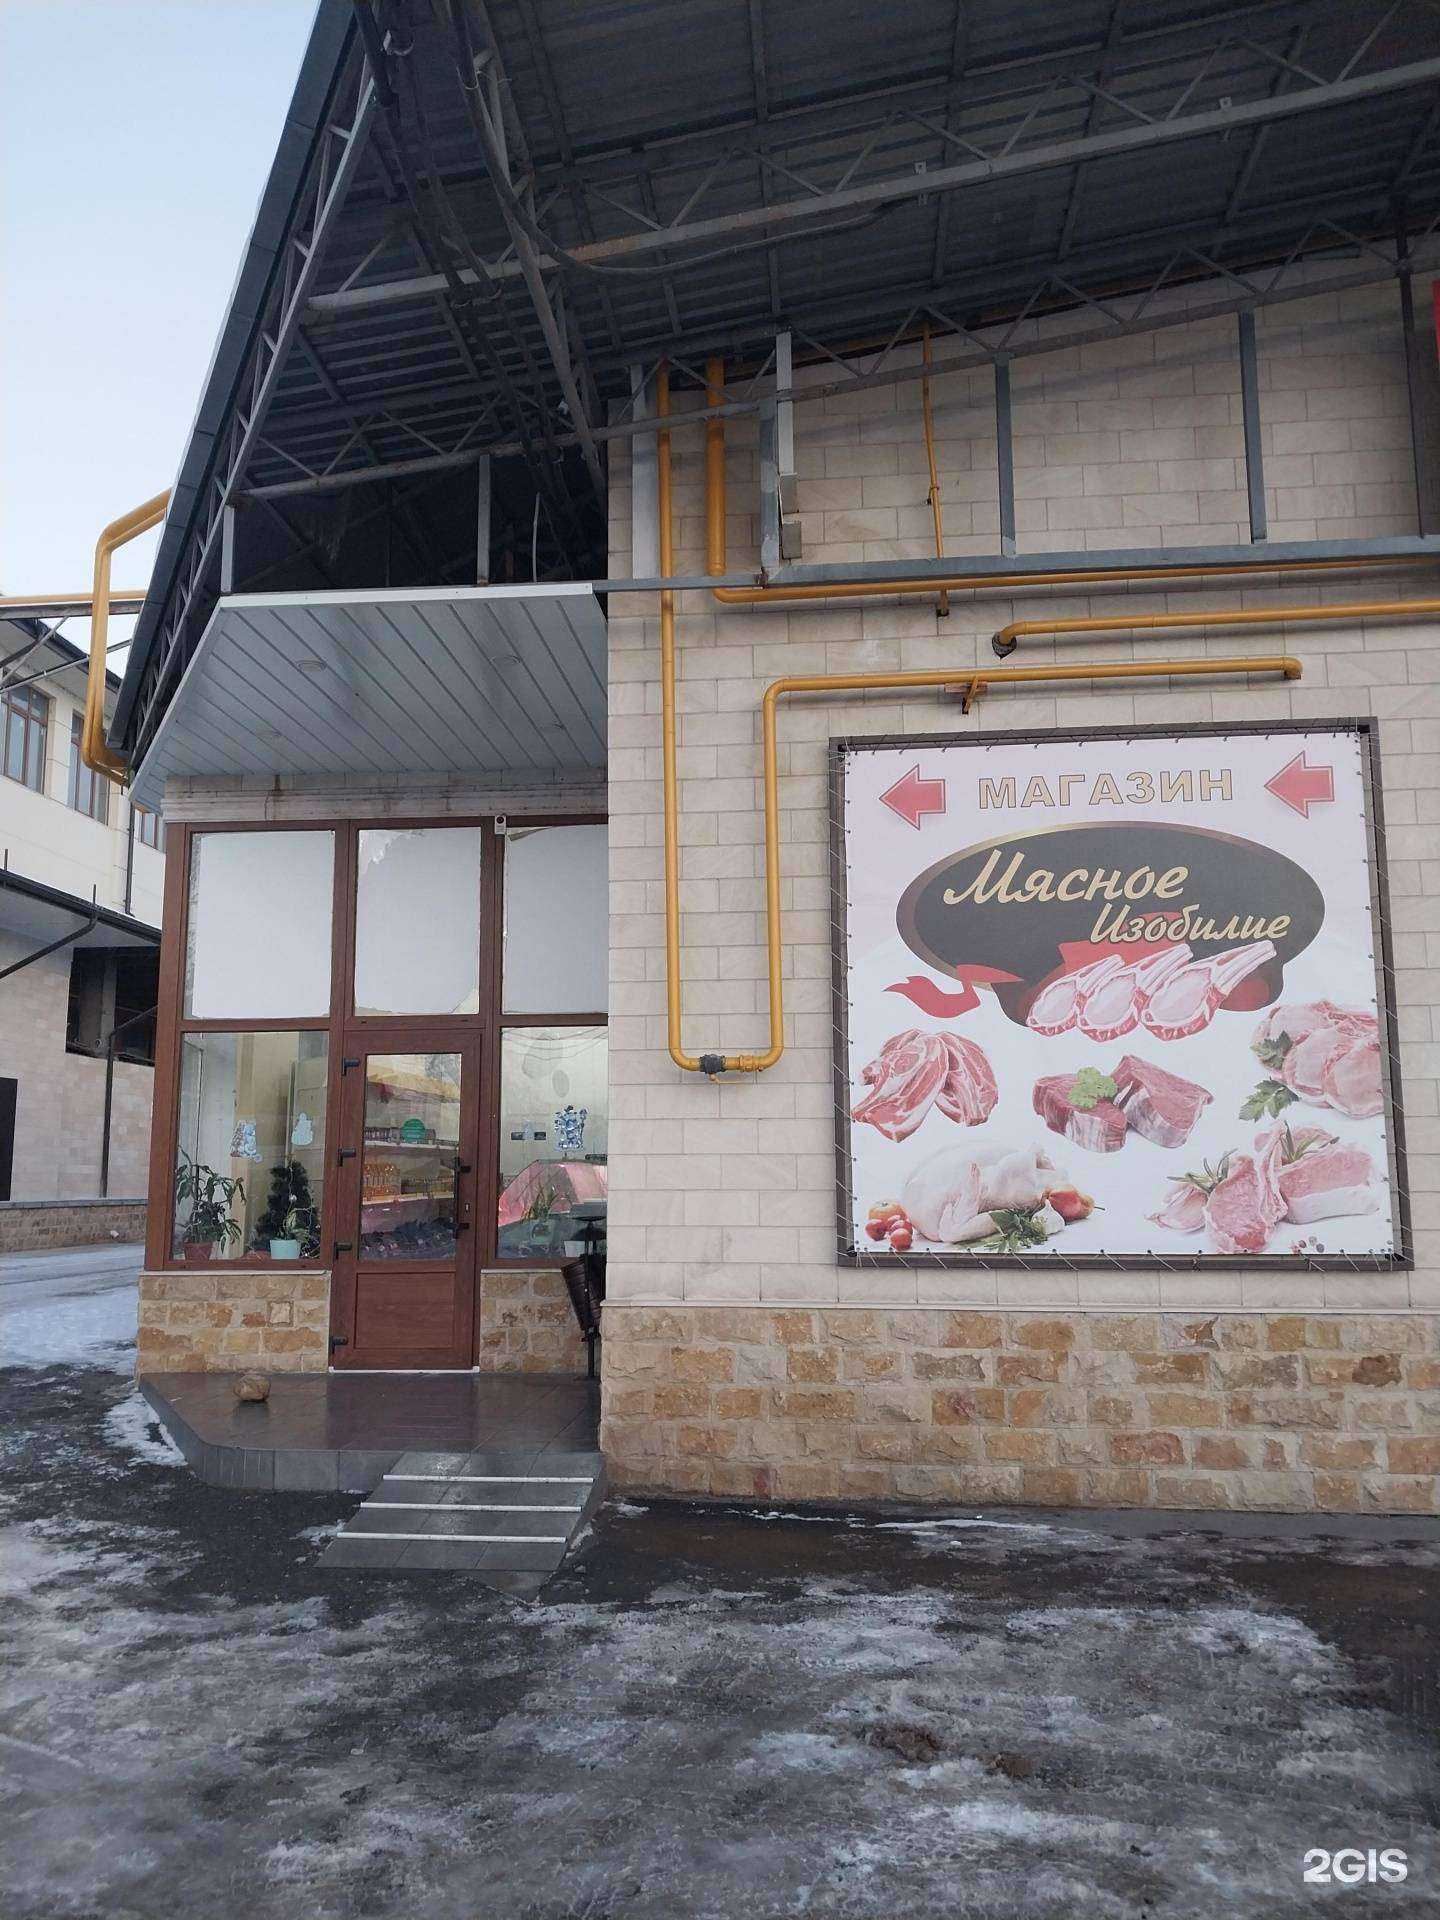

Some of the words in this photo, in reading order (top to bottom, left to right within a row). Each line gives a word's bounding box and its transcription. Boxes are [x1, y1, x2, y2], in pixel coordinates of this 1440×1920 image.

[978, 768, 1233, 810] МАГАЗИН
[943, 849, 1190, 905] Мясное
[1090, 903, 1292, 943] Изобилие
